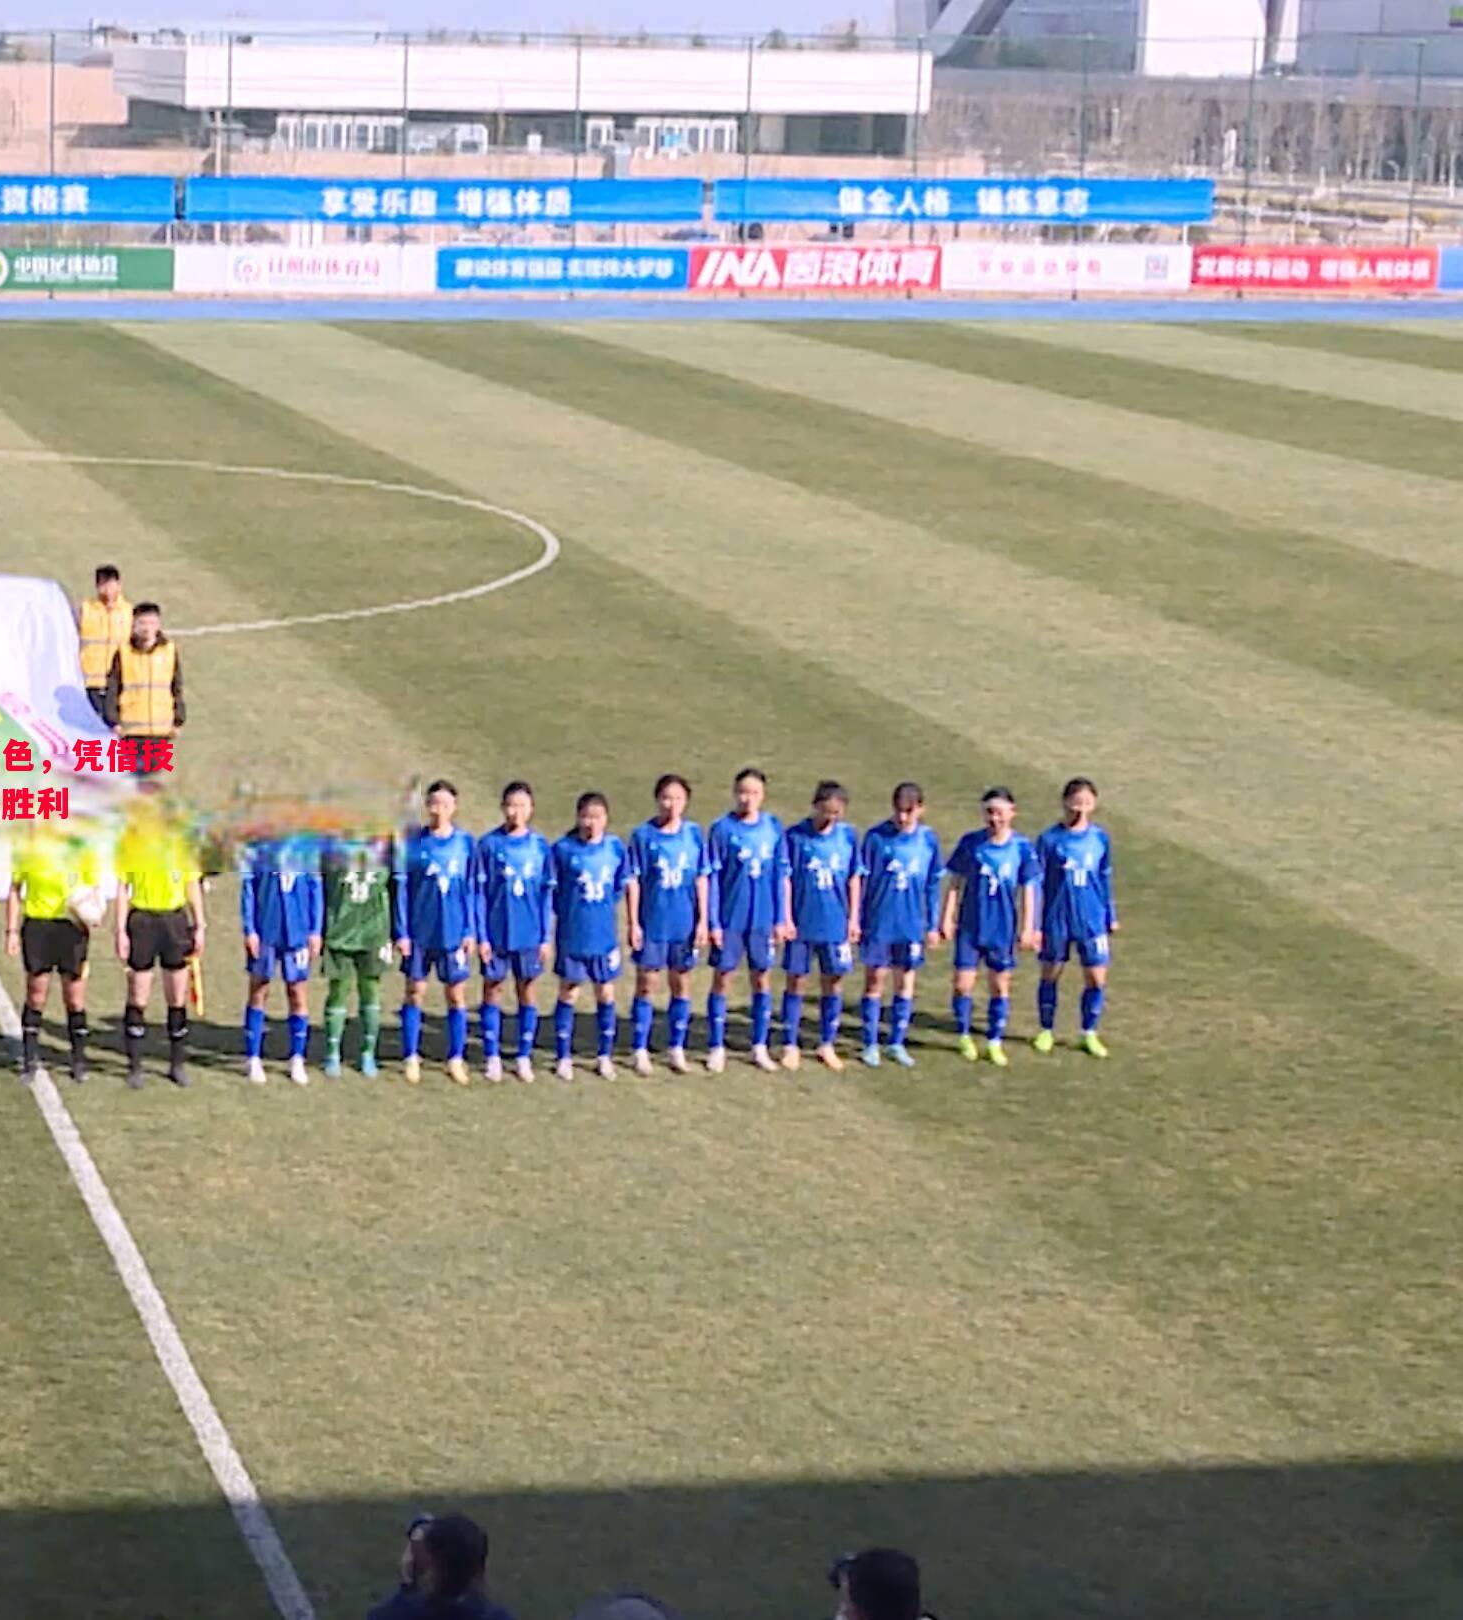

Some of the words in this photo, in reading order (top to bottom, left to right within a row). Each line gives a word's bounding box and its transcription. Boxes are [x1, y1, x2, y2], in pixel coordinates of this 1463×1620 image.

[321, 188, 437, 218] 享受乐趣
[457, 188, 572, 218] 增强体质
[839, 187, 951, 217] 健全人格
[978, 187, 1090, 216] 锻炼意志
[697, 250, 780, 287] INA
